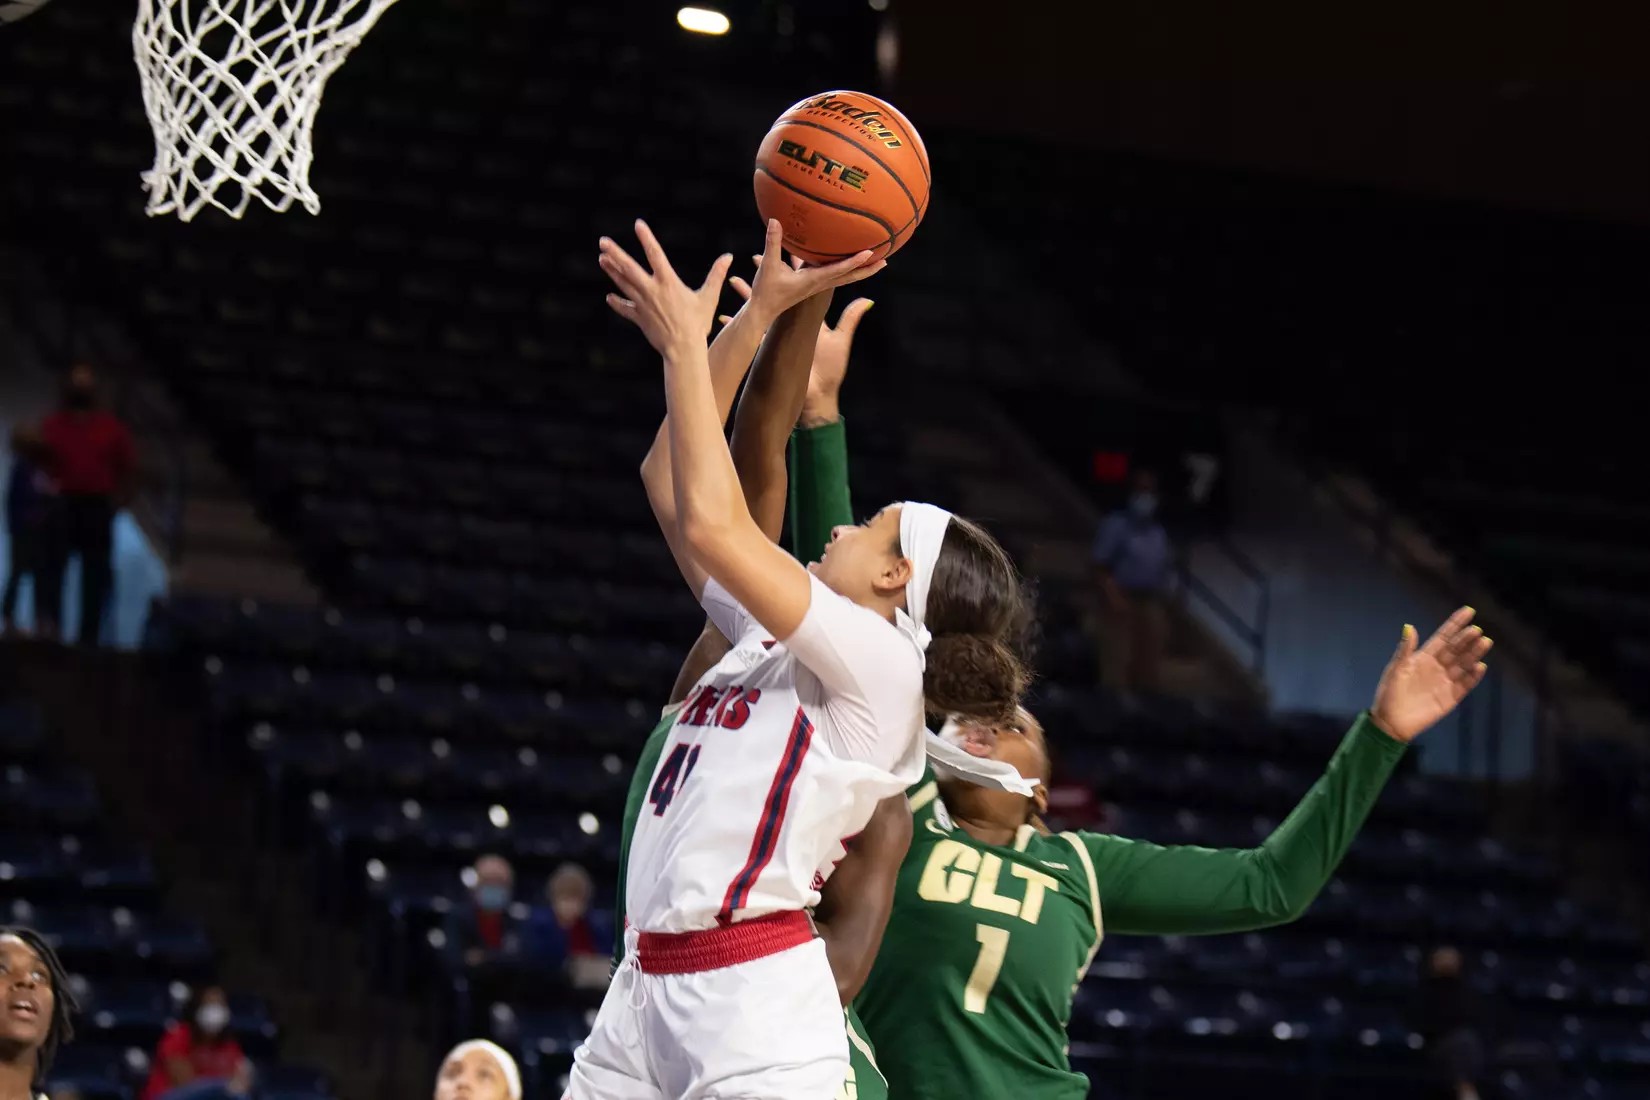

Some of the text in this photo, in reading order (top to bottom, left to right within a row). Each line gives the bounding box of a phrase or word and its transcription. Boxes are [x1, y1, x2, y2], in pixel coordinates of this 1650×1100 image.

[777, 139, 867, 190] ELITE
[818, 174, 844, 191] BALL
[917, 838, 1059, 925] CLT
[964, 923, 1010, 1014] 1
